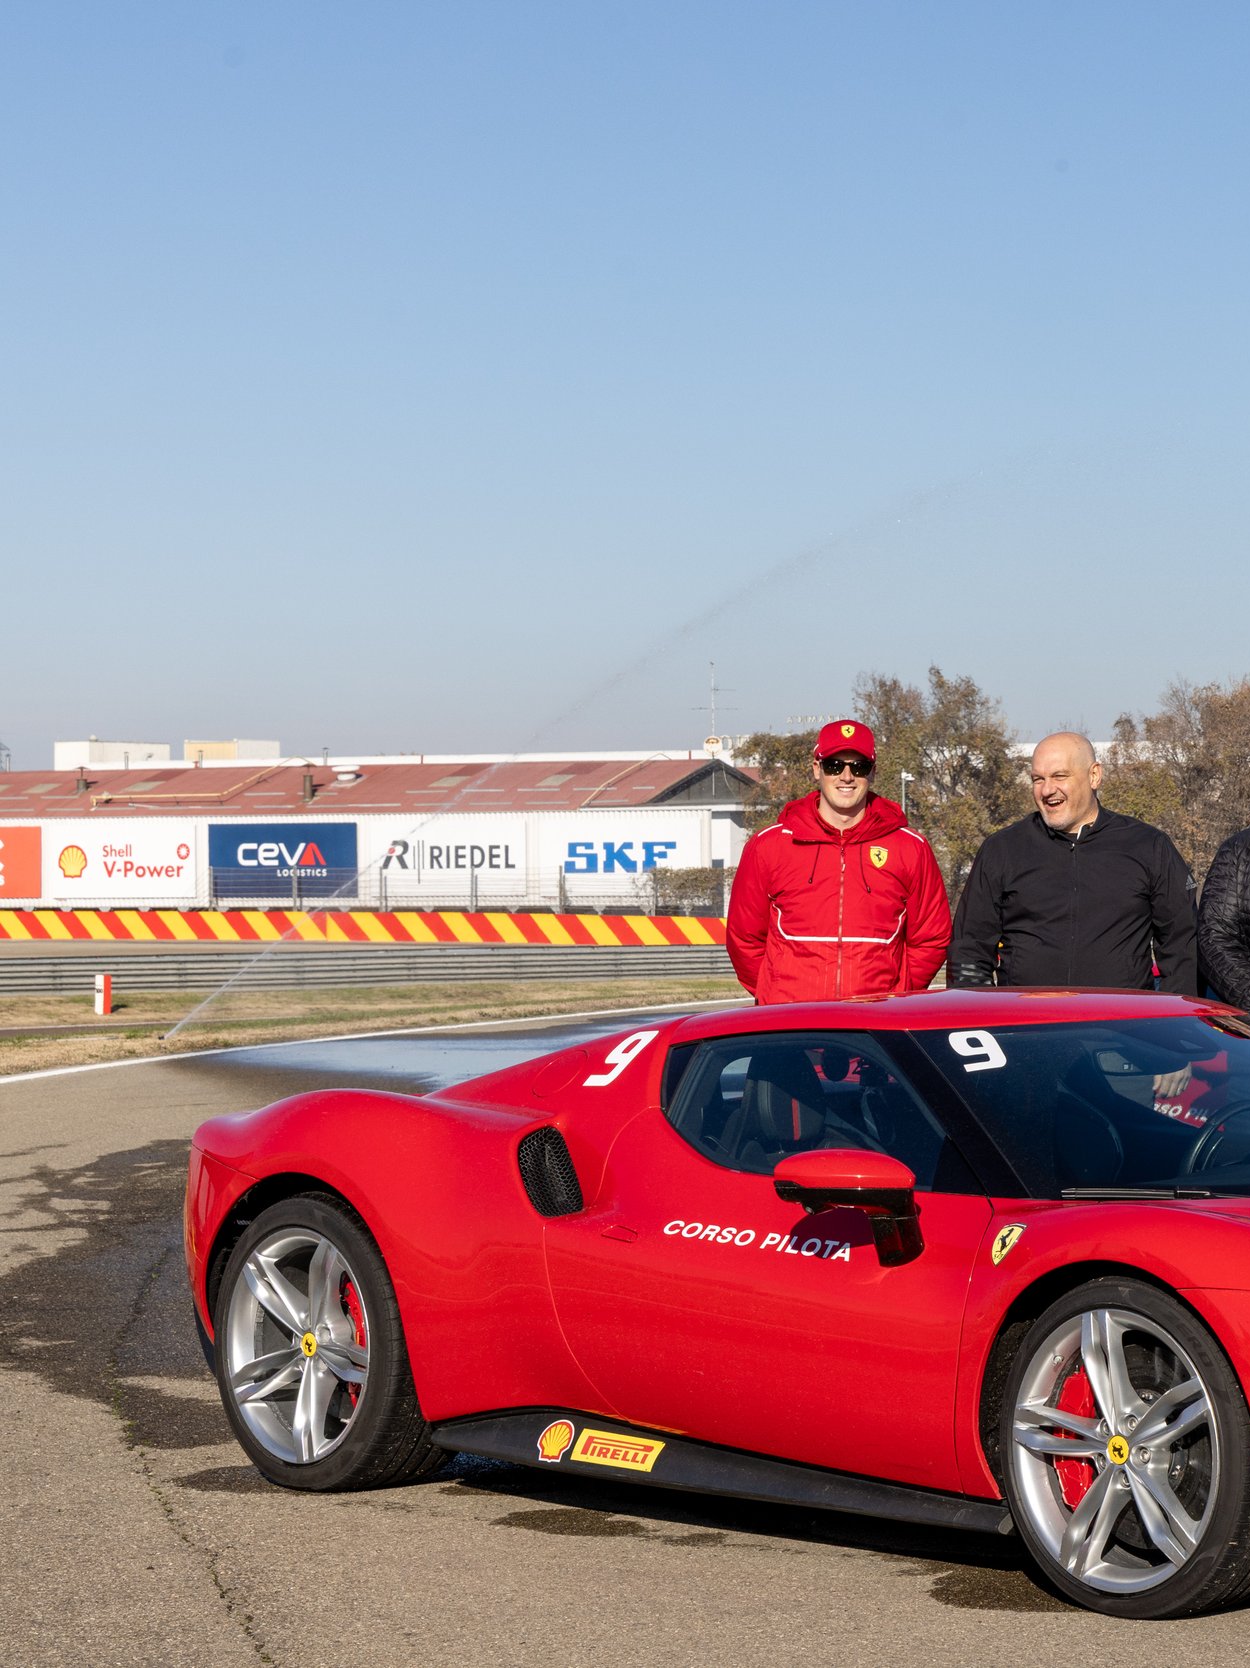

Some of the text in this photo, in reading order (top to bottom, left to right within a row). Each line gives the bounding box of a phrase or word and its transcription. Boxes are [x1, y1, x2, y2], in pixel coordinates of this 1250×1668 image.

[102, 844, 132, 857] Shell
[429, 845, 516, 869] RIEDEL
[564, 841, 677, 873] SKF
[103, 860, 184, 878] V-Power
[582, 1030, 659, 1087] 9
[948, 1030, 1007, 1073] 9
[663, 1220, 851, 1262] CORSO PILOTA
[580, 1435, 654, 1464] PIRELLI
